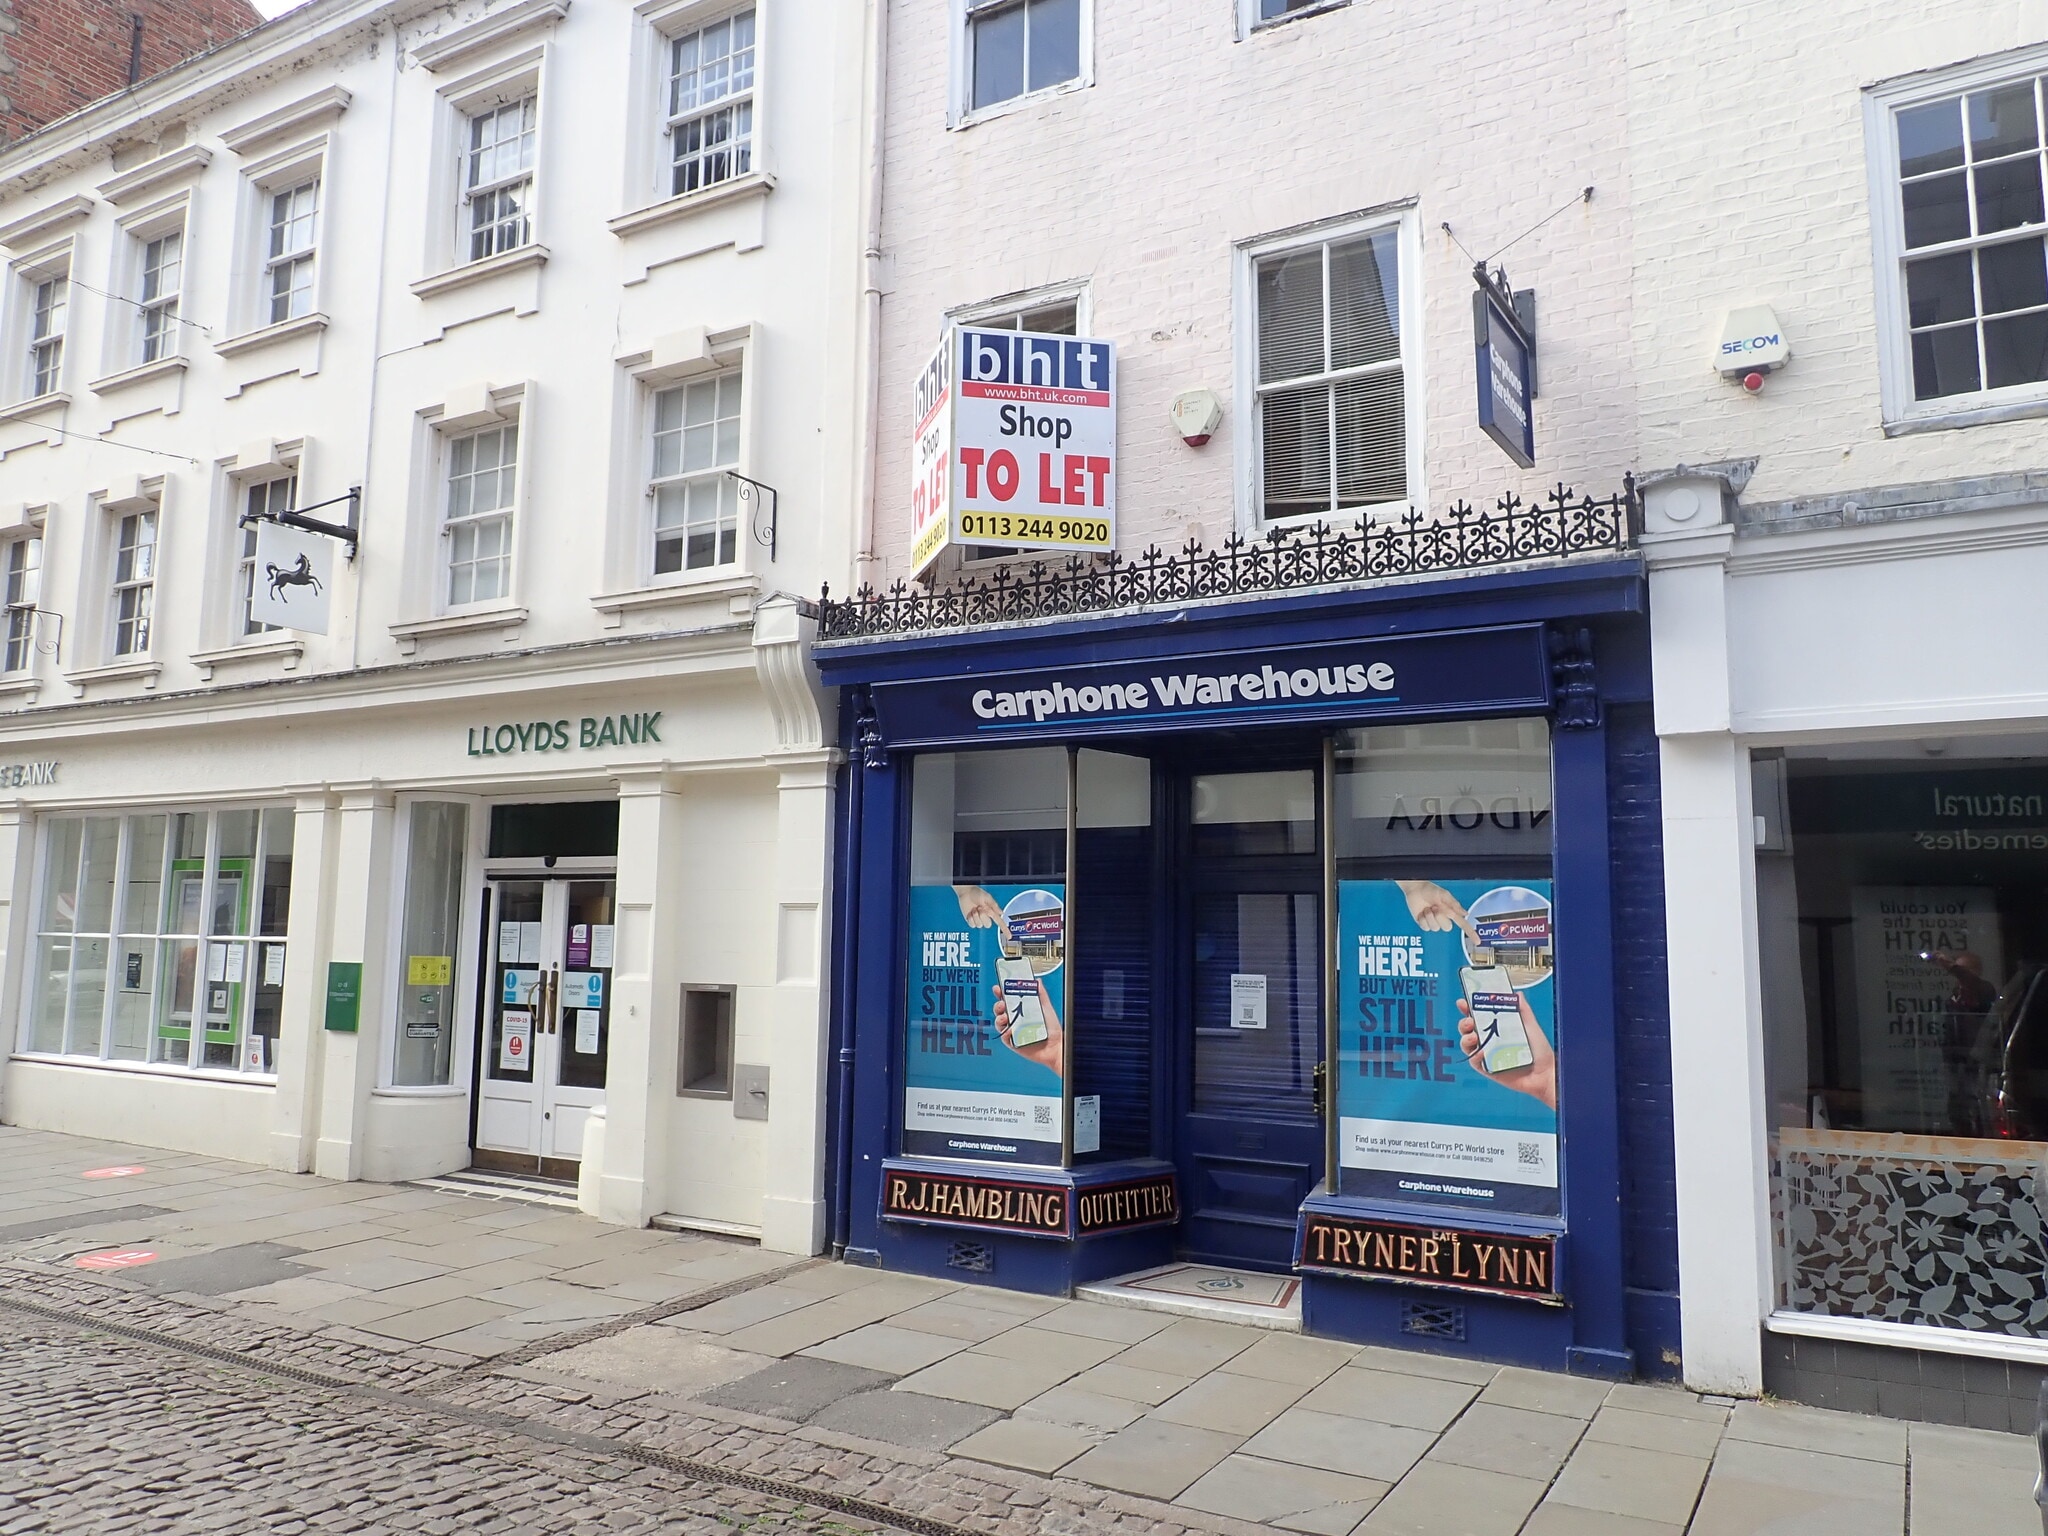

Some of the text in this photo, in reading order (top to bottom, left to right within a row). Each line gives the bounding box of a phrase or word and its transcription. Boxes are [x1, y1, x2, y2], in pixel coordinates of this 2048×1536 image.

[1722, 334, 1778, 354] SECOM
[971, 334, 1098, 389] bht
[1490, 344, 1523, 397] Carphone
[916, 353, 947, 425] bht
[985, 387, 1087, 404] www.bht.uk.com
[1491, 370, 1527, 427] Warehouse
[1000, 404, 1072, 448] Shop
[922, 428, 939, 464] Shop
[960, 447, 1110, 507] TO LET
[913, 479, 925, 535] TO
[929, 450, 948, 516] LET
[933, 520, 946, 548] 9020
[962, 515, 1108, 541] 0113 244 9020
[972, 662, 1394, 721] Carphone Warehouse
[467, 711, 662, 756] LLOYDS BANK
[12, 761, 58, 787] BANK
[923, 932, 969, 941] WE MAY NOT BE
[1041, 921, 1059, 929] World
[1478, 924, 1544, 936] Currys PC World
[923, 942, 981, 967] HERE...
[1358, 935, 1421, 947] WE MAY NOT BE
[922, 969, 980, 984] BUT WE'RE
[1359, 947, 1439, 977] HERE...
[922, 985, 983, 1017] STILL
[1359, 978, 1438, 997] BUT WE'RE
[1359, 997, 1442, 1035] STILL
[921, 1017, 992, 1056] HERE
[1359, 1035, 1456, 1082] HERE
[917, 1102, 928, 1110] Find
[953, 1105, 971, 1113] nearest
[972, 1106, 989, 1115] Currys
[998, 1107, 1013, 1116] World
[1013, 1109, 1026, 1117] store
[948, 1139, 1017, 1152] Carphone Warehouse
[1355, 1135, 1368, 1143] Find
[1379, 1137, 1386, 1145] at
[1387, 1139, 1402, 1147] your
[1404, 1140, 1429, 1149] nearest
[1430, 1141, 1453, 1151] Currys
[1454, 1143, 1463, 1151] PC
[1465, 1144, 1485, 1153] World
[1487, 1147, 1505, 1155] store
[1399, 1180, 1494, 1198] Carphone Warehouse
[1080, 1184, 1174, 1227] OUTFITTER
[1312, 1225, 1440, 1275] TRYNER
[1452, 1241, 1547, 1287] LYNN
